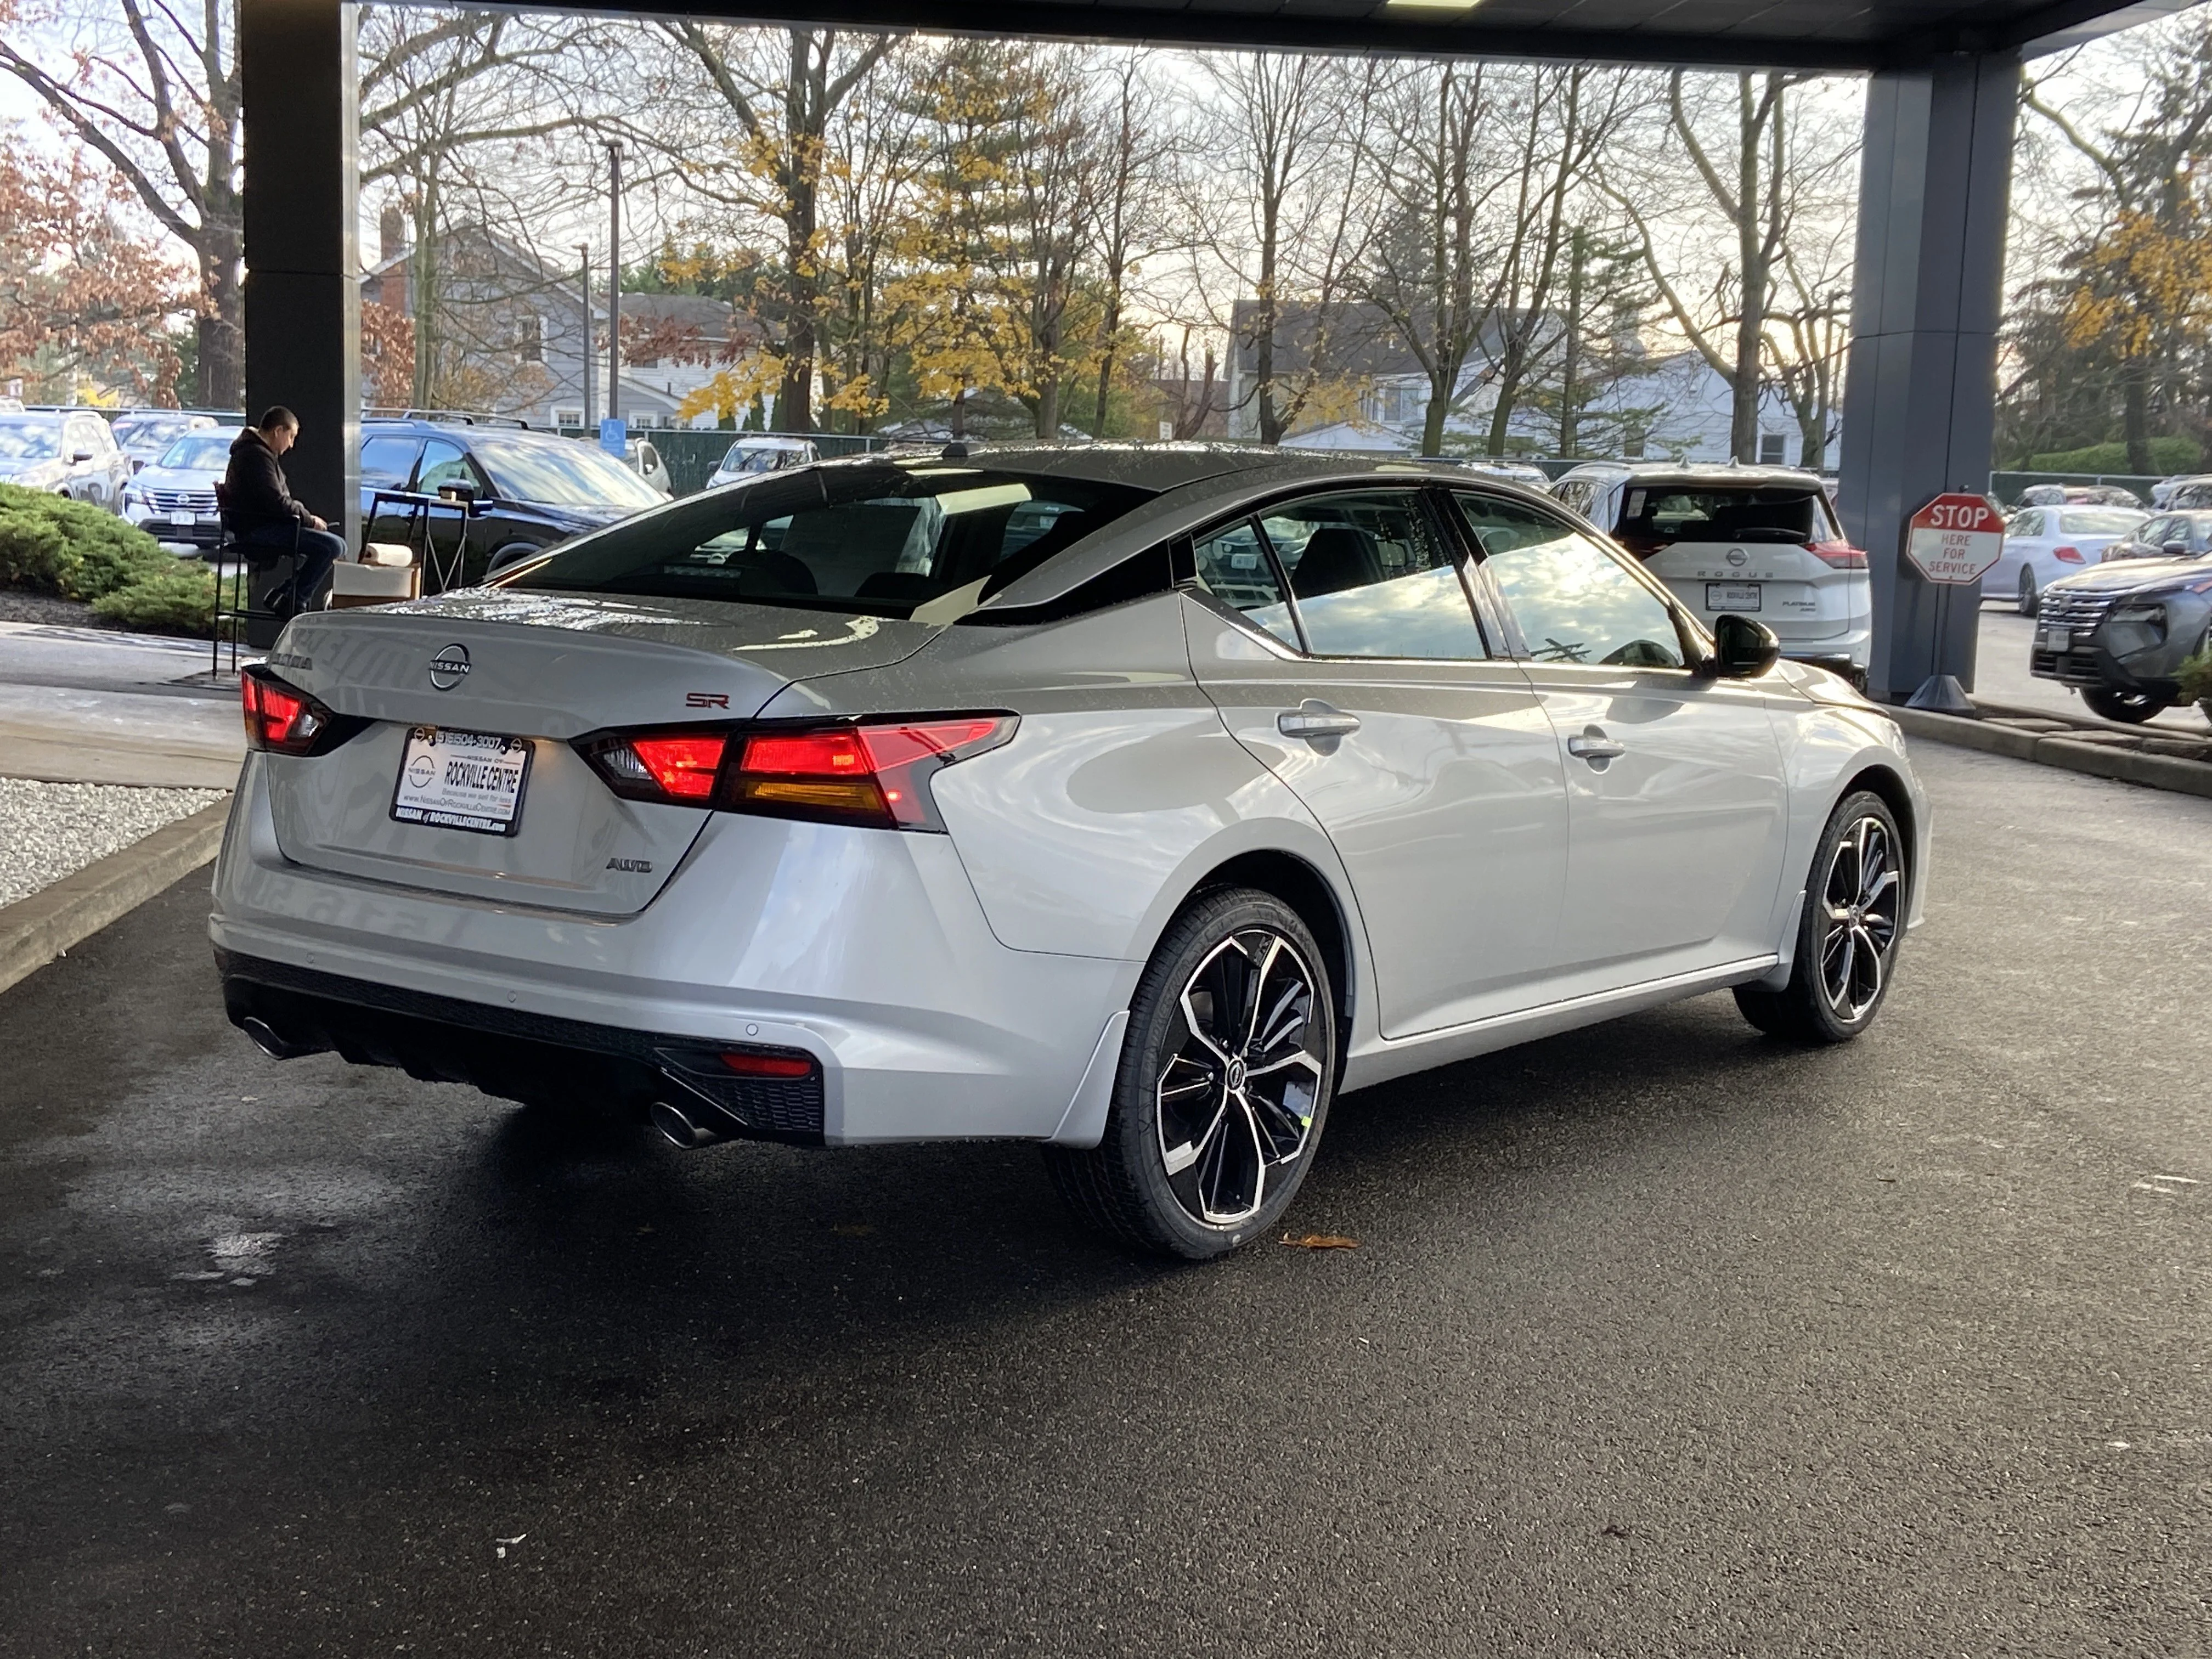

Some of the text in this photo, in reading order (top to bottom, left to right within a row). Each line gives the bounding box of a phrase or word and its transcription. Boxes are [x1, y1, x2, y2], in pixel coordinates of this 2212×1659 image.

[1930, 504, 1989, 529] STOP
[1941, 533, 1972, 546] HERE
[1942, 548, 1966, 560] FOR
[1928, 561, 1977, 575] SERVICE
[430, 661, 471, 674] NISSAN
[685, 692, 731, 710] SR
[467, 755, 493, 763] NISSAN
[408, 767, 436, 776] NISSAN
[444, 761, 519, 793] ROCKVILLE CENTRE
[605, 857, 653, 873] AWD
